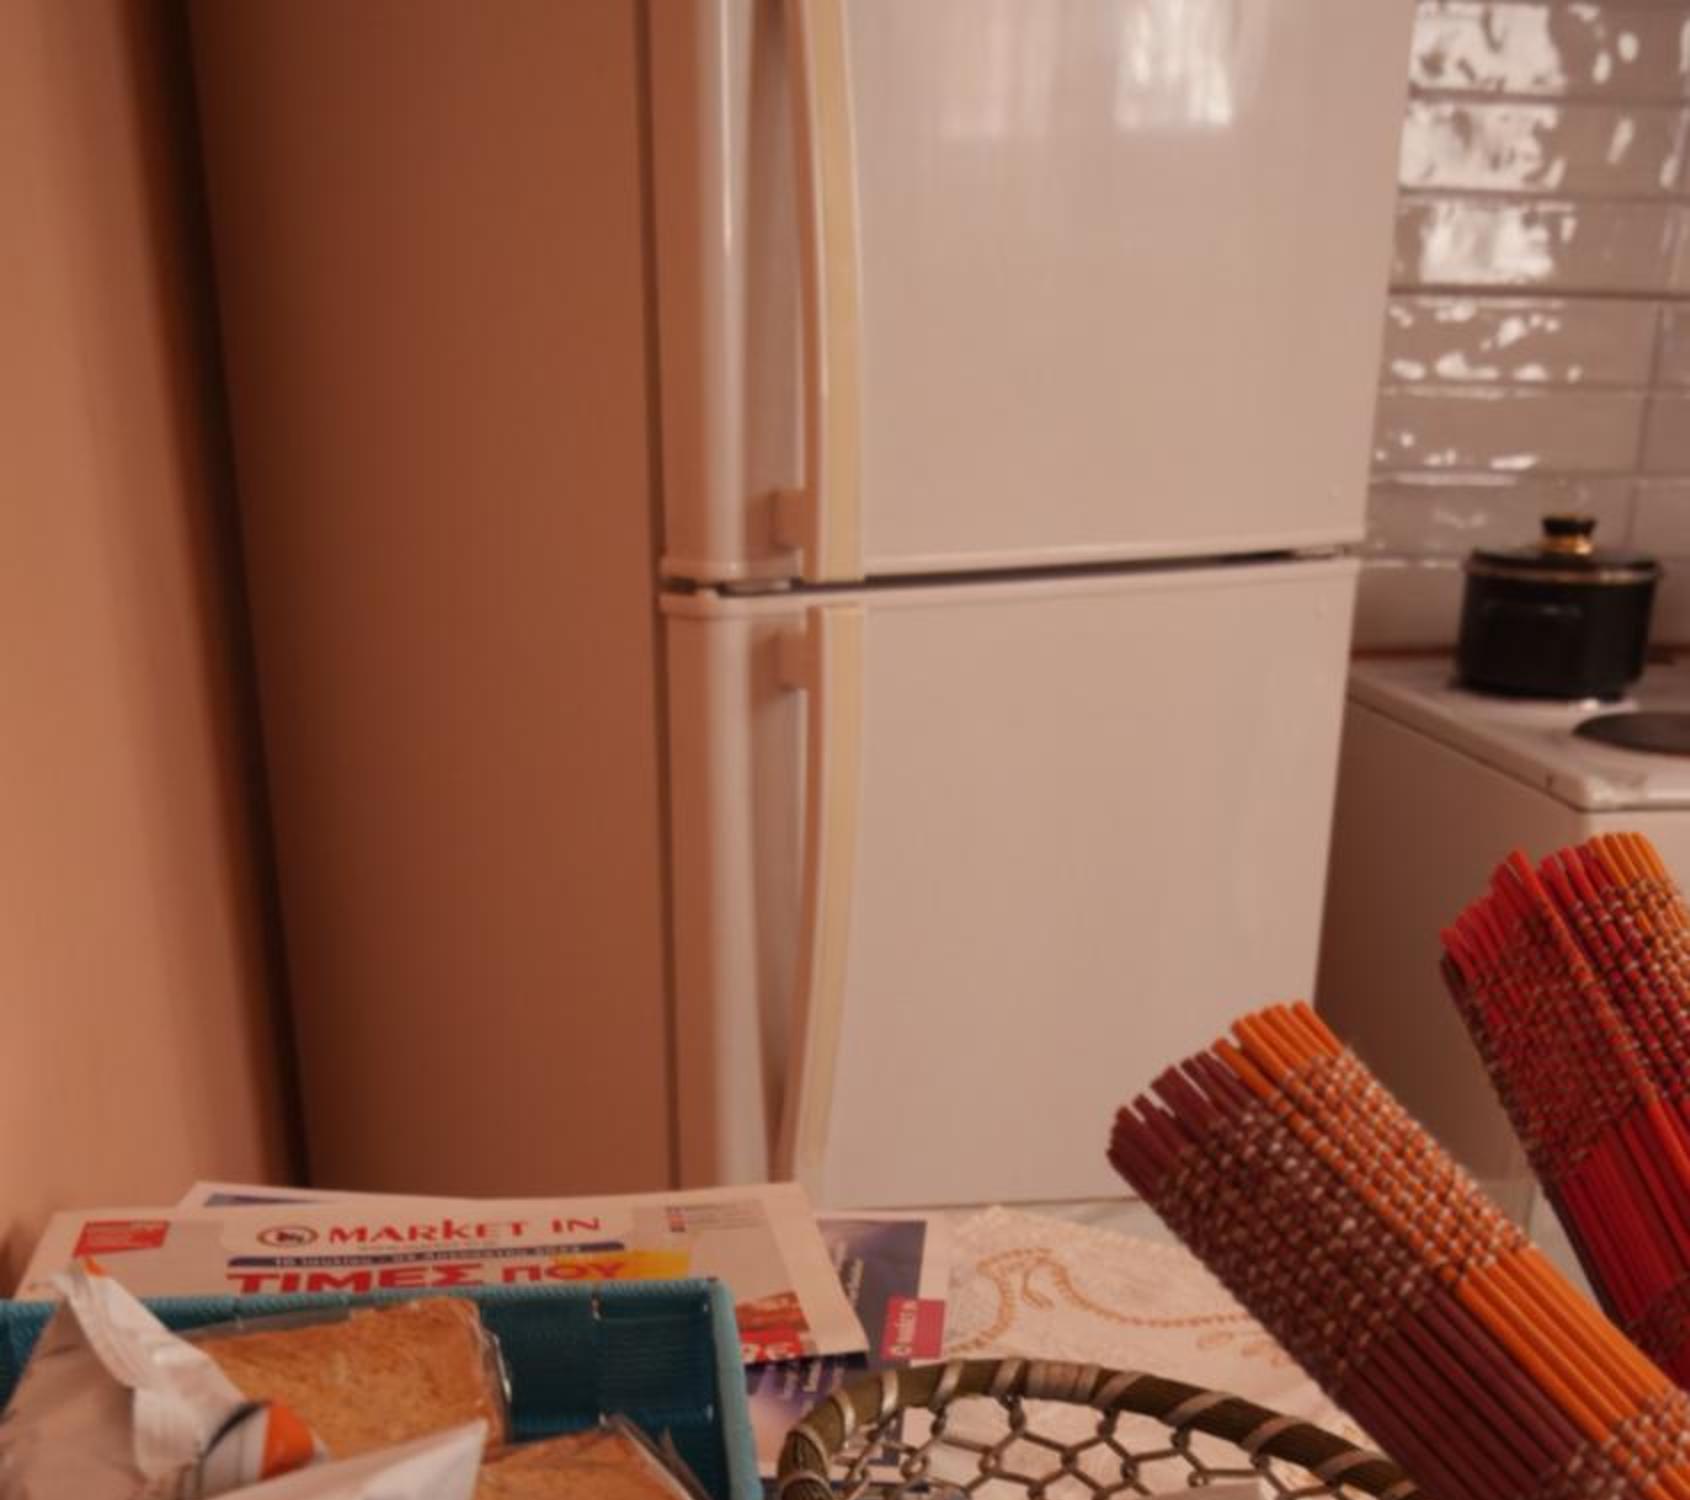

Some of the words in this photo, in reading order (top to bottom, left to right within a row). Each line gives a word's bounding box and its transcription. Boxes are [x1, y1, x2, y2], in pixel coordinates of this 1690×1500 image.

[551, 1217, 600, 1233] IN
[226, 1262, 484, 1295] ΤΙΜΕΣ
[502, 1261, 624, 1284] ΠΟΥ
